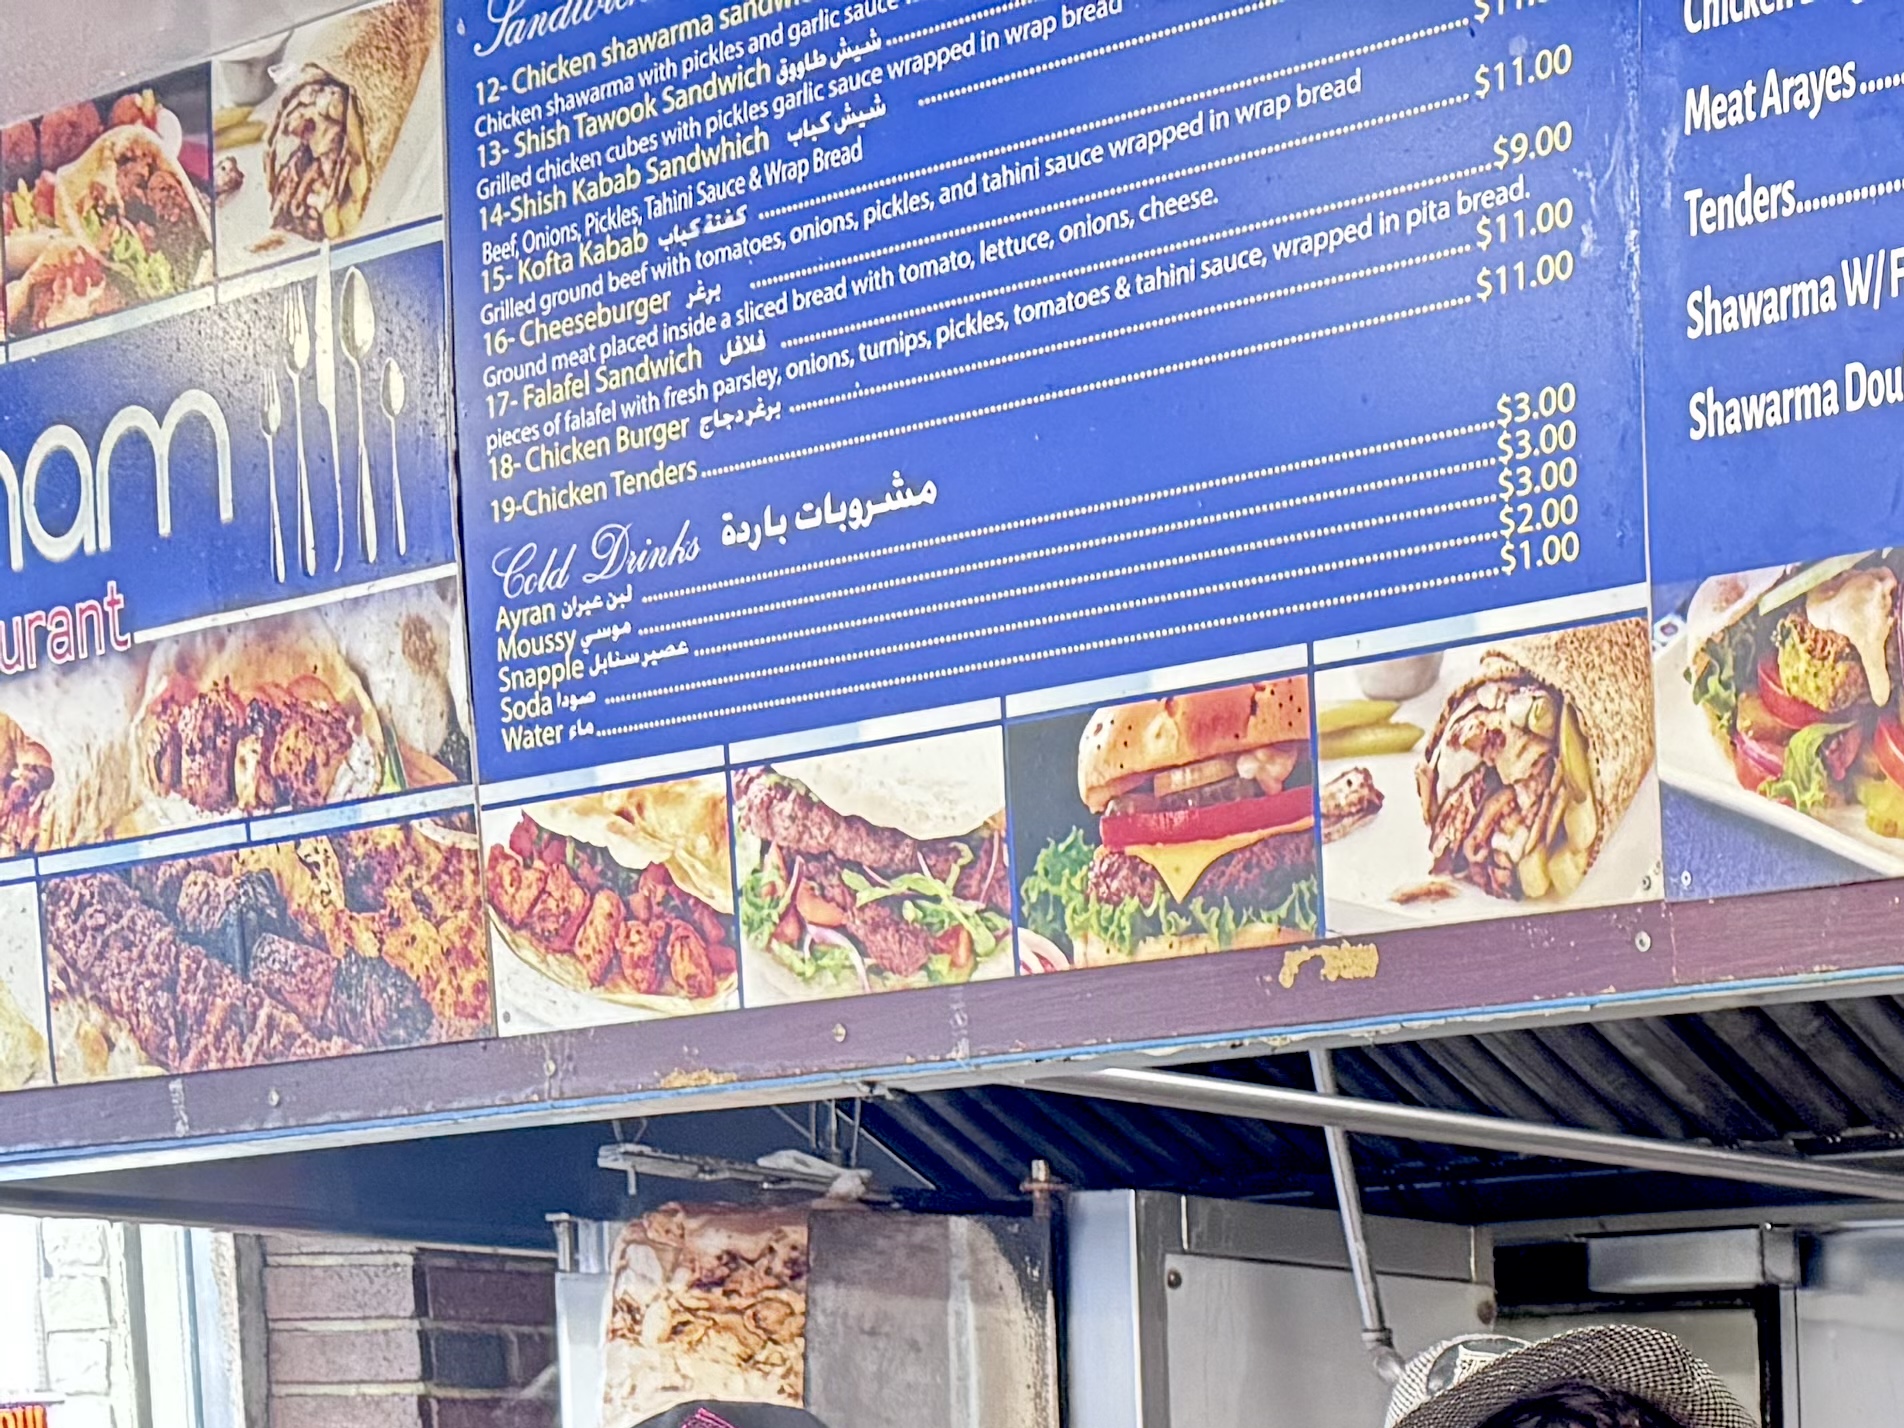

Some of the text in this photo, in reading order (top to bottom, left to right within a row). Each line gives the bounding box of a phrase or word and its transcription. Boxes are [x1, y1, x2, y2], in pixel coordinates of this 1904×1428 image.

[475, 9, 840, 137] Chicken shawarma with pickles and garlic
[476, 77, 508, 105] 12-
[511, 51, 597, 95] Chicken
[602, 14, 713, 67] shawarma
[1475, 44, 1572, 99] $11.00
[477, 0, 1122, 199] Grilled chicken cubes with pickles garlic sauce wrapped in wrap bread
[477, 57, 771, 168] 13- Shish Tawook Sandwich
[1685, 61, 1857, 135] Meat Arayes
[573, 163, 641, 205] Kabab
[646, 125, 769, 184] Sandwhich
[1493, 121, 1572, 170] $9.00
[481, 68, 1361, 325] Grilled ground beef with tomatoes, onions, pickles, and tahini sauce wrapped in wrap bread
[483, 138, 862, 265] Beef, Onions, Pickles, Tahini Sauce & Wrap Bread
[1476, 198, 1573, 251] $11.00
[1684, 173, 1796, 236] Tenders
[481, 227, 648, 294] 15- Kofta Kabab
[484, 188, 1219, 388] Ground meat placed inside a sliced bread with tomato, lettuce, onions, cheese.
[1476, 250, 1574, 303] $11.00
[484, 291, 672, 356] 16- Cheeseburger
[487, 174, 1530, 455] pieces of falafel with fresh parsley, onions, turnips, pickles, tomatoes & tahini sauce, wrapped in pita bread.
[1687, 276, 1838, 339] Shawarma
[1841, 249, 1886, 310] W/
[486, 343, 702, 419] 17- Falafel Sandwich
[1496, 382, 1576, 428] $3.00
[1690, 380, 1839, 440] Shawarma
[489, 417, 690, 481] 18- Chicken Burger
[1497, 419, 1577, 465] $3.00
[610, 460, 697, 497] Tenders
[1498, 457, 1578, 502] $3.00
[721, 470, 937, 551] مشروبات باردة
[1499, 494, 1579, 539] $2.00
[491, 519, 701, 599] Cold Drinks
[1500, 531, 1580, 576] $1.00
[496, 602, 556, 637] Ayran
[498, 628, 577, 662] Moussy
[499, 655, 584, 692] Snapple
[501, 691, 553, 723] Soda
[501, 724, 564, 753] Water
